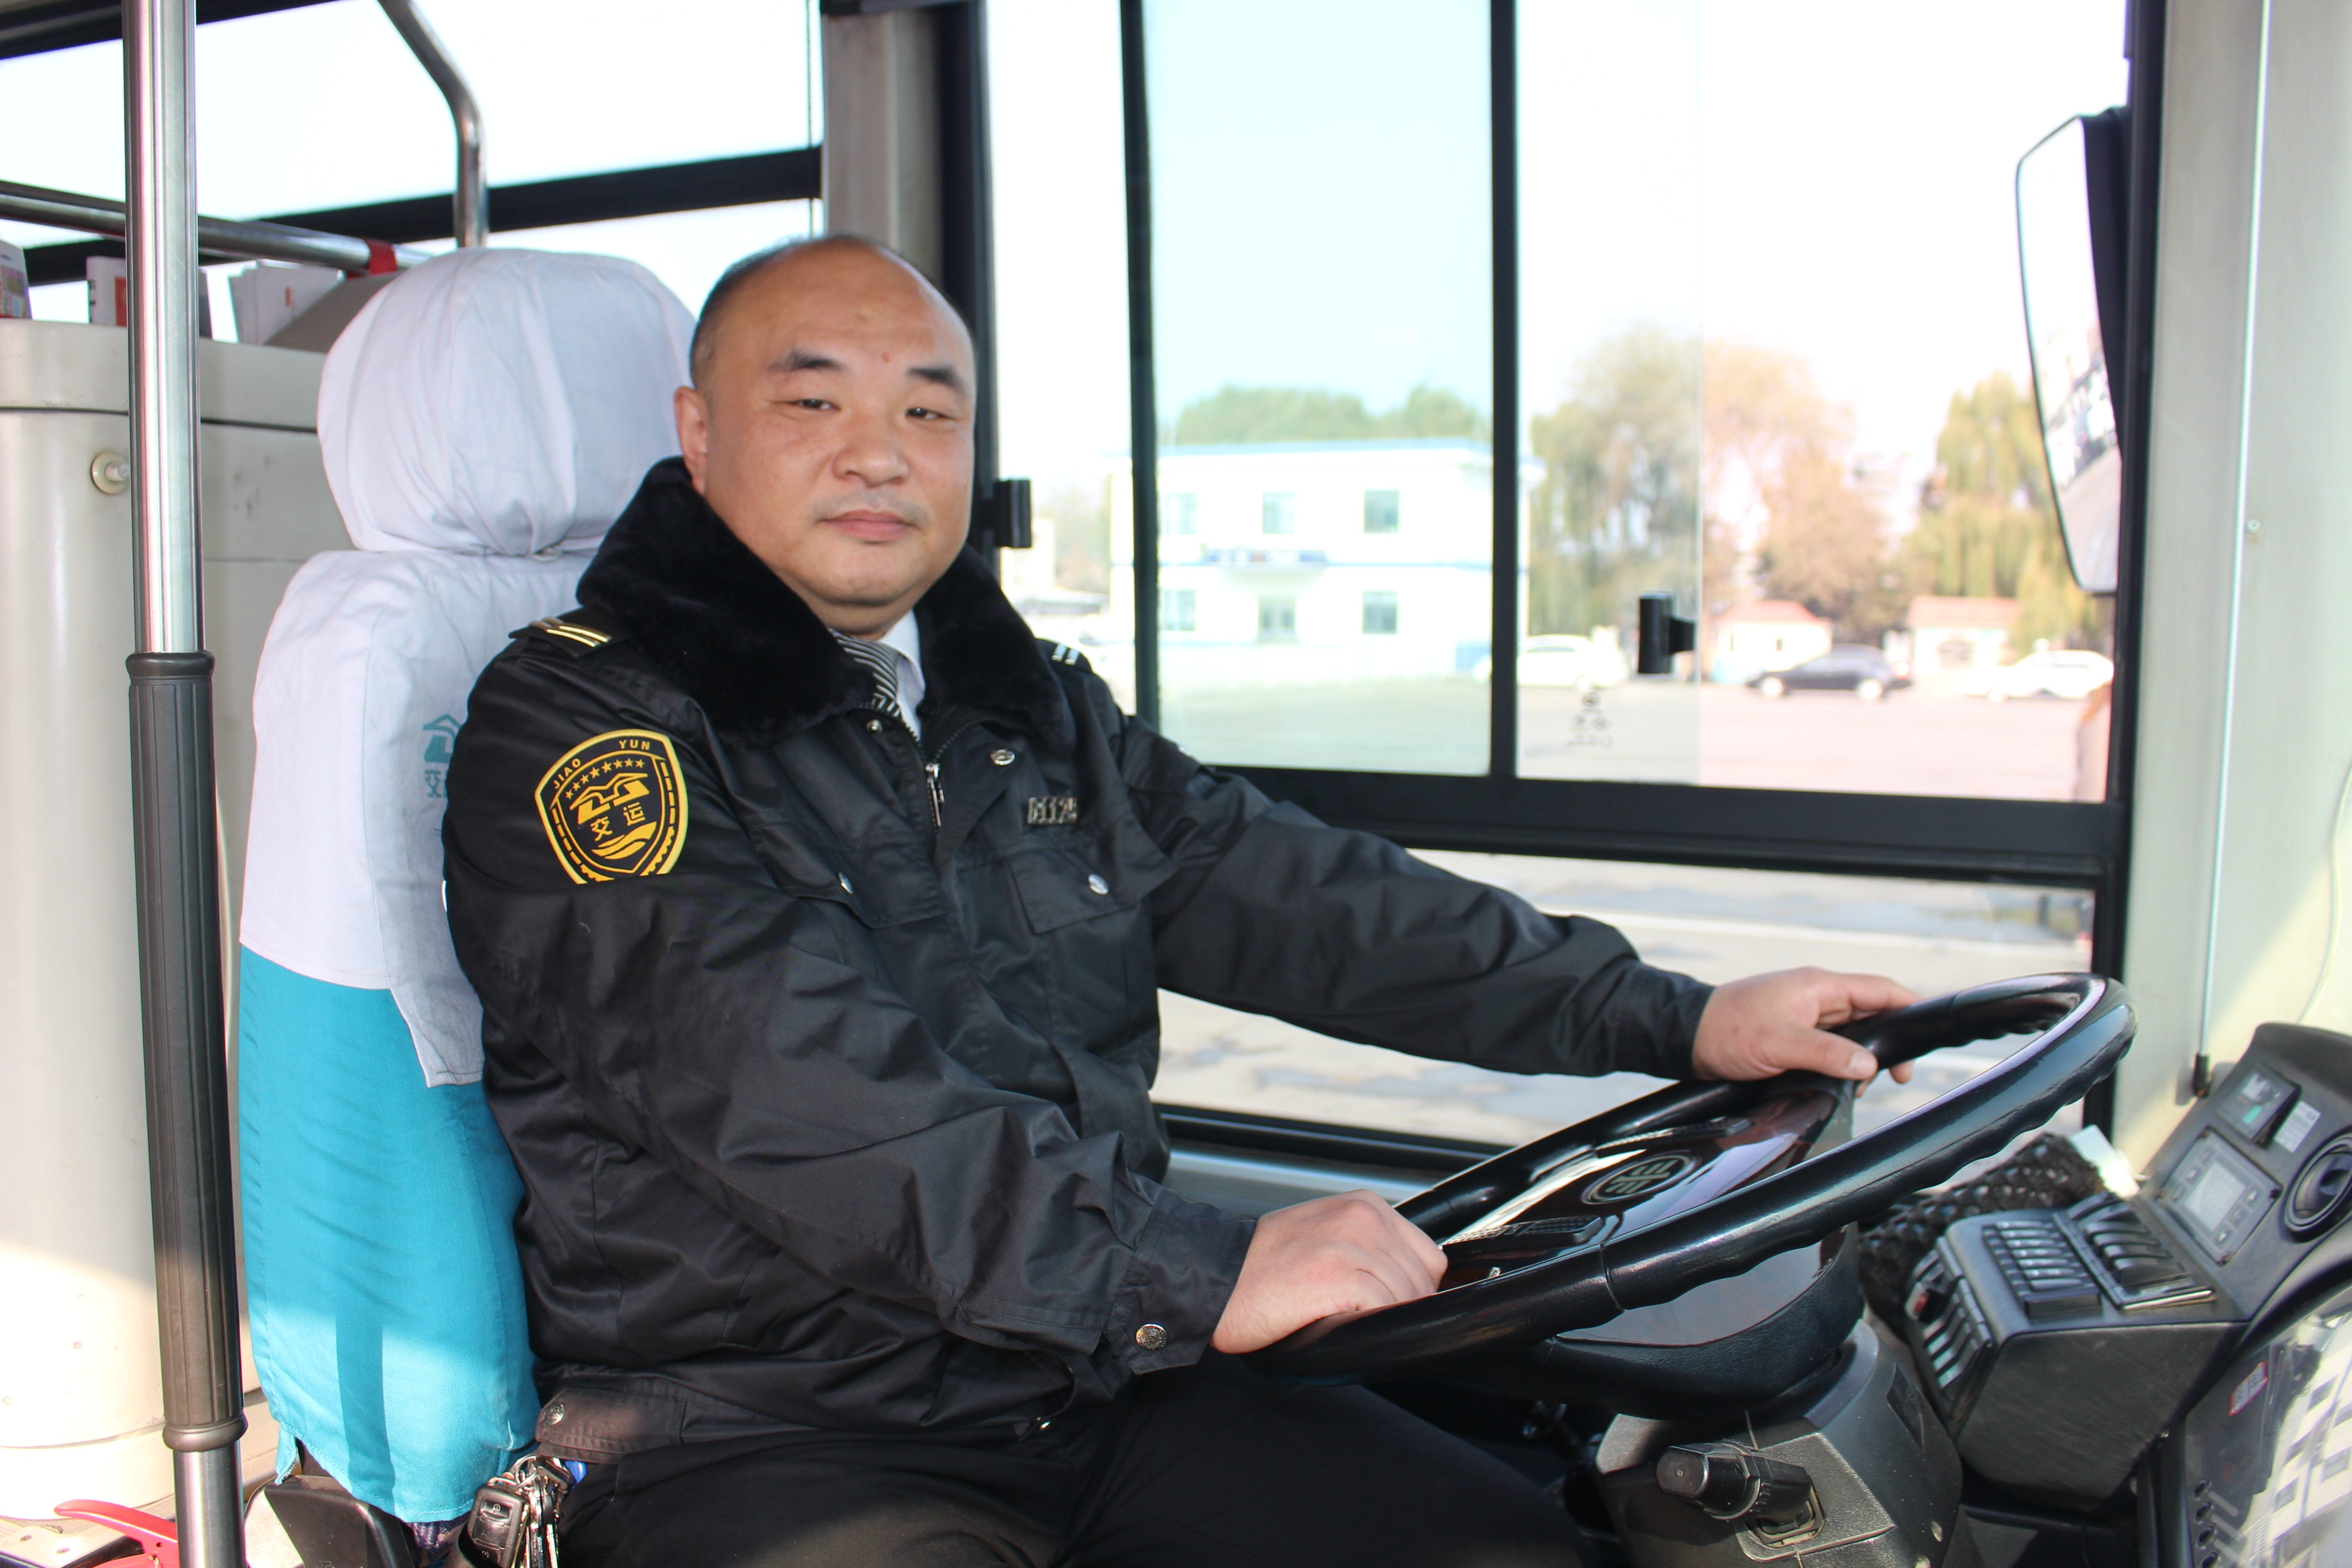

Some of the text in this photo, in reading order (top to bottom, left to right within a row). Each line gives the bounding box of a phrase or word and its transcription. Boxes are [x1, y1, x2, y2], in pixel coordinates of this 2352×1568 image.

[424, 769, 446, 798] 交
[553, 739, 650, 789] JIAO YUN
